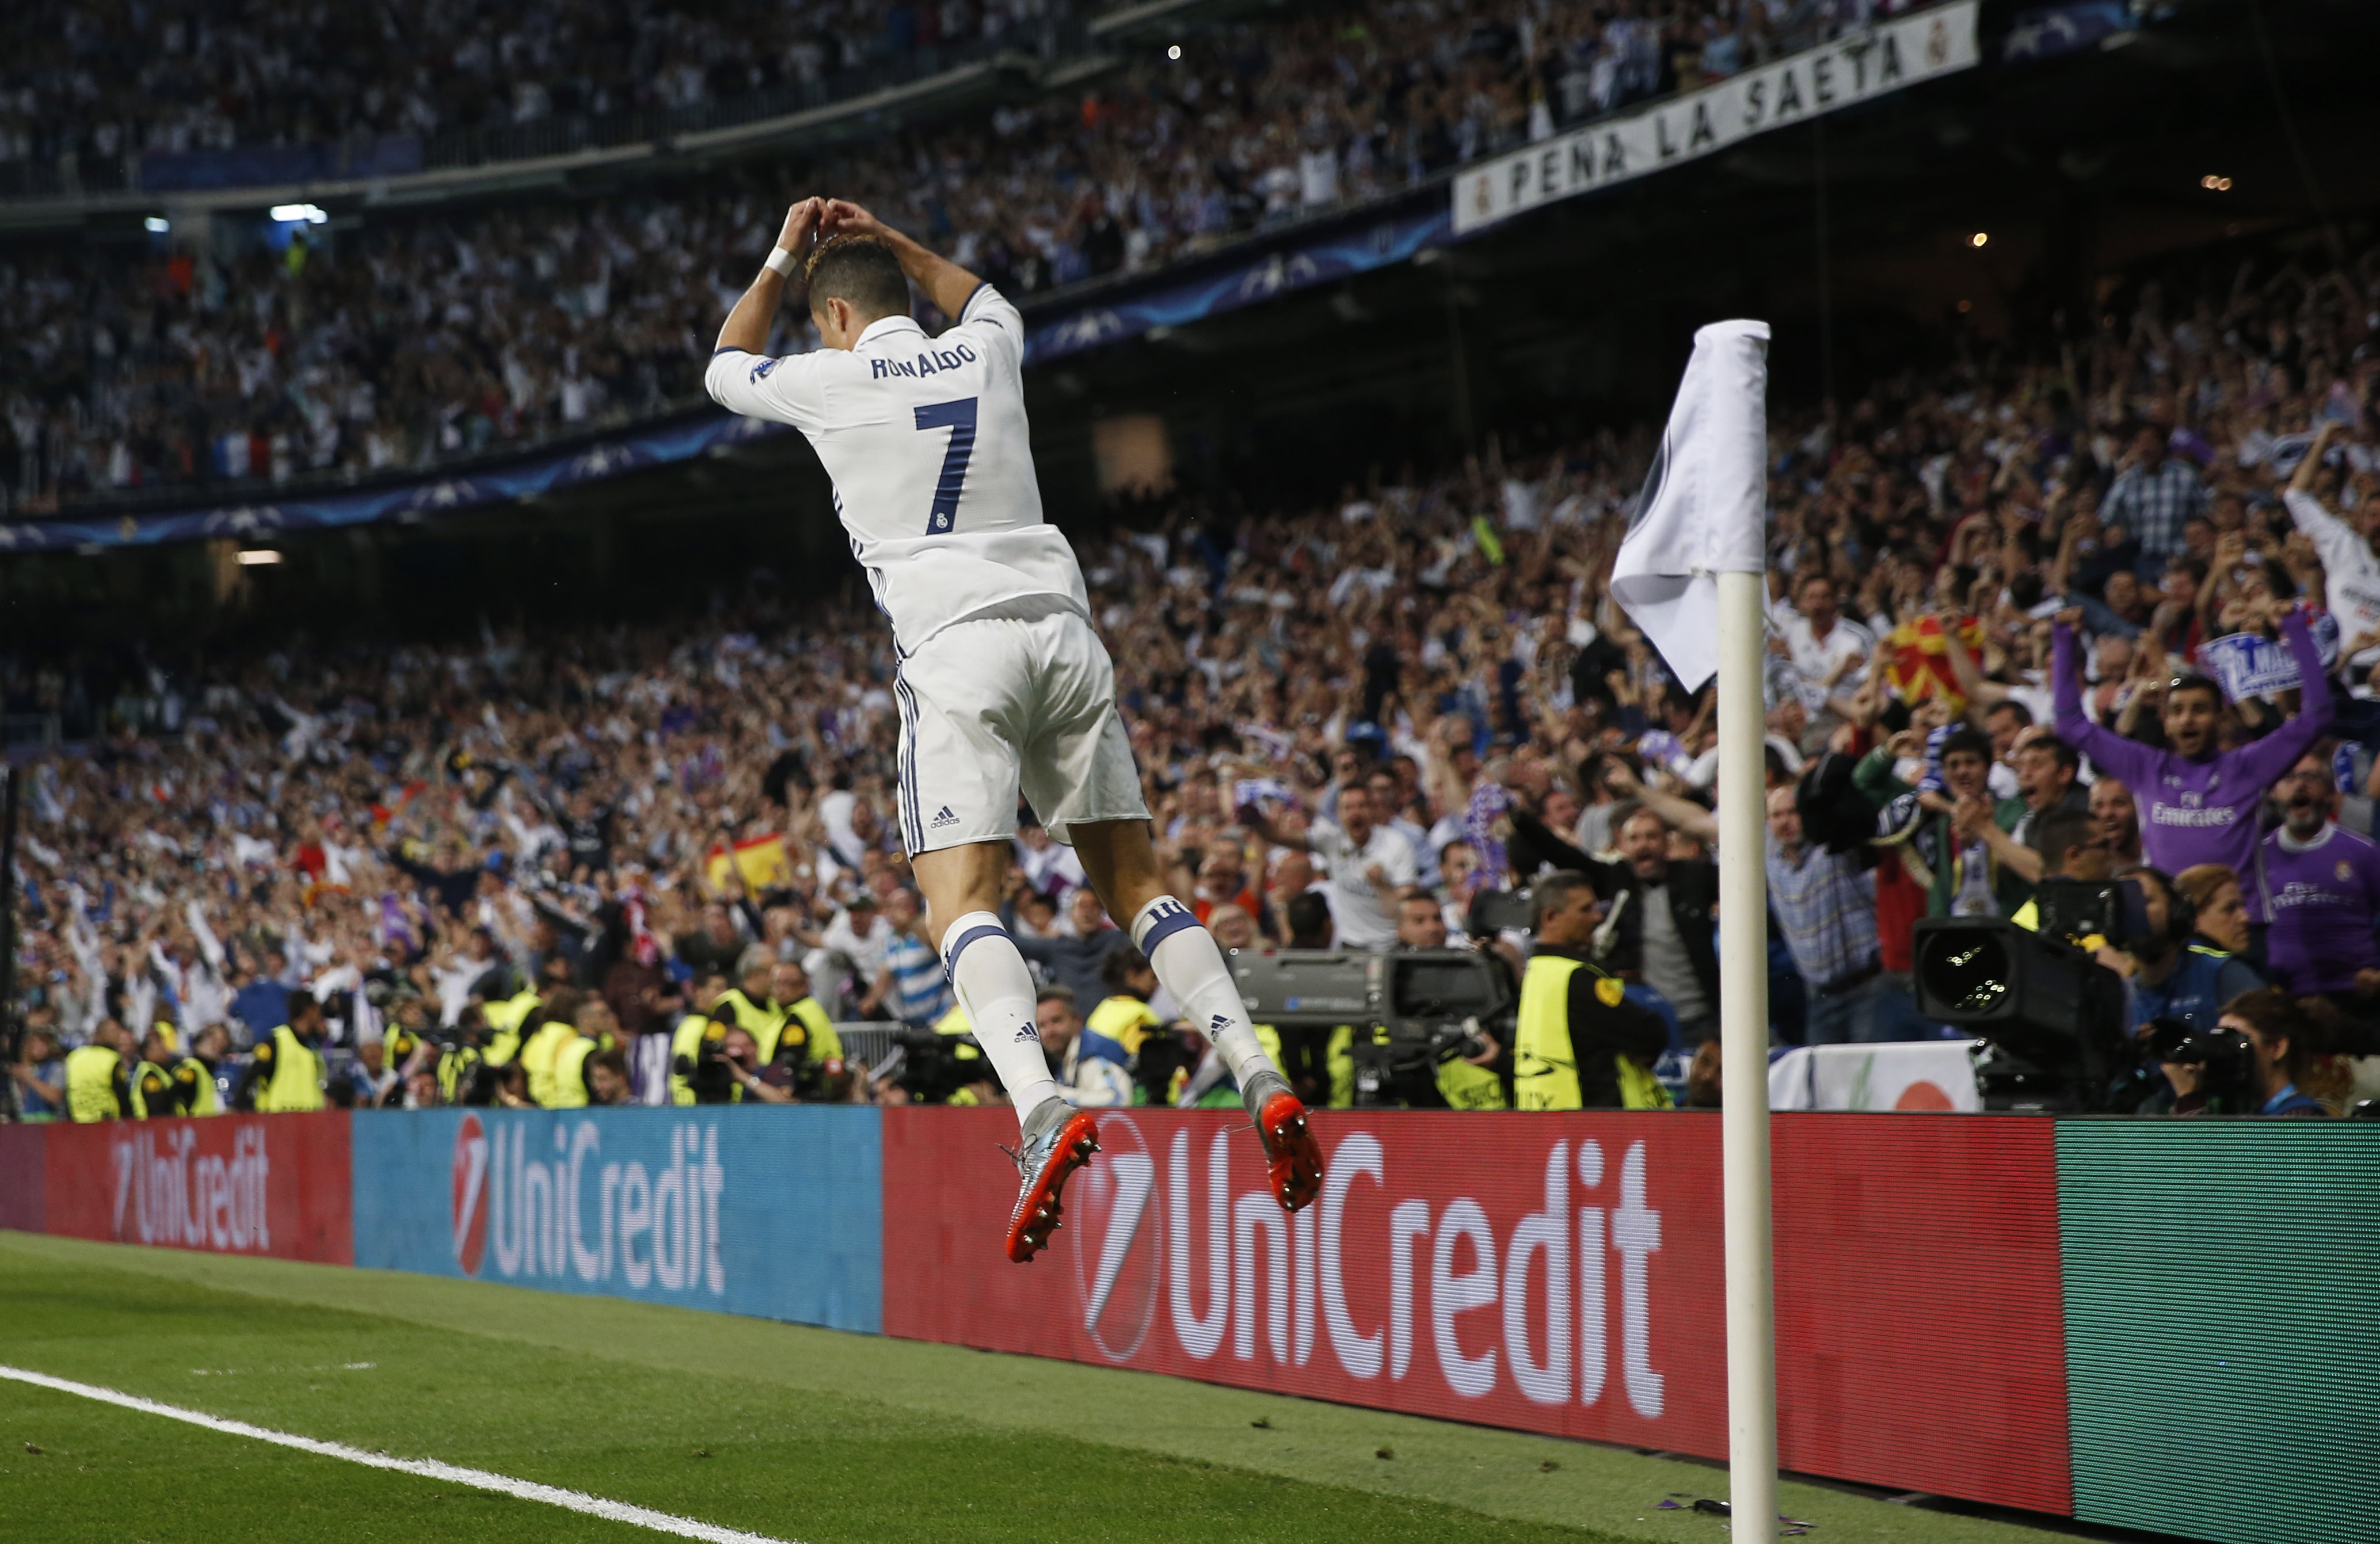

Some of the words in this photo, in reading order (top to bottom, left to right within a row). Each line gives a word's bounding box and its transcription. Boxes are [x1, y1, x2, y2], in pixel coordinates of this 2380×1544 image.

[1655, 102, 1716, 157] LA
[1744, 35, 1902, 125] SAETA
[871, 344, 977, 379] RONALDO
[913, 396, 978, 535] 7
[930, 817, 961, 829] adidas
[2151, 802, 2236, 828] Emirates
[134, 1124, 270, 1251] UniCredit
[493, 1120, 725, 1295] UniCredit
[1168, 1126, 1665, 1419] UniCredit
